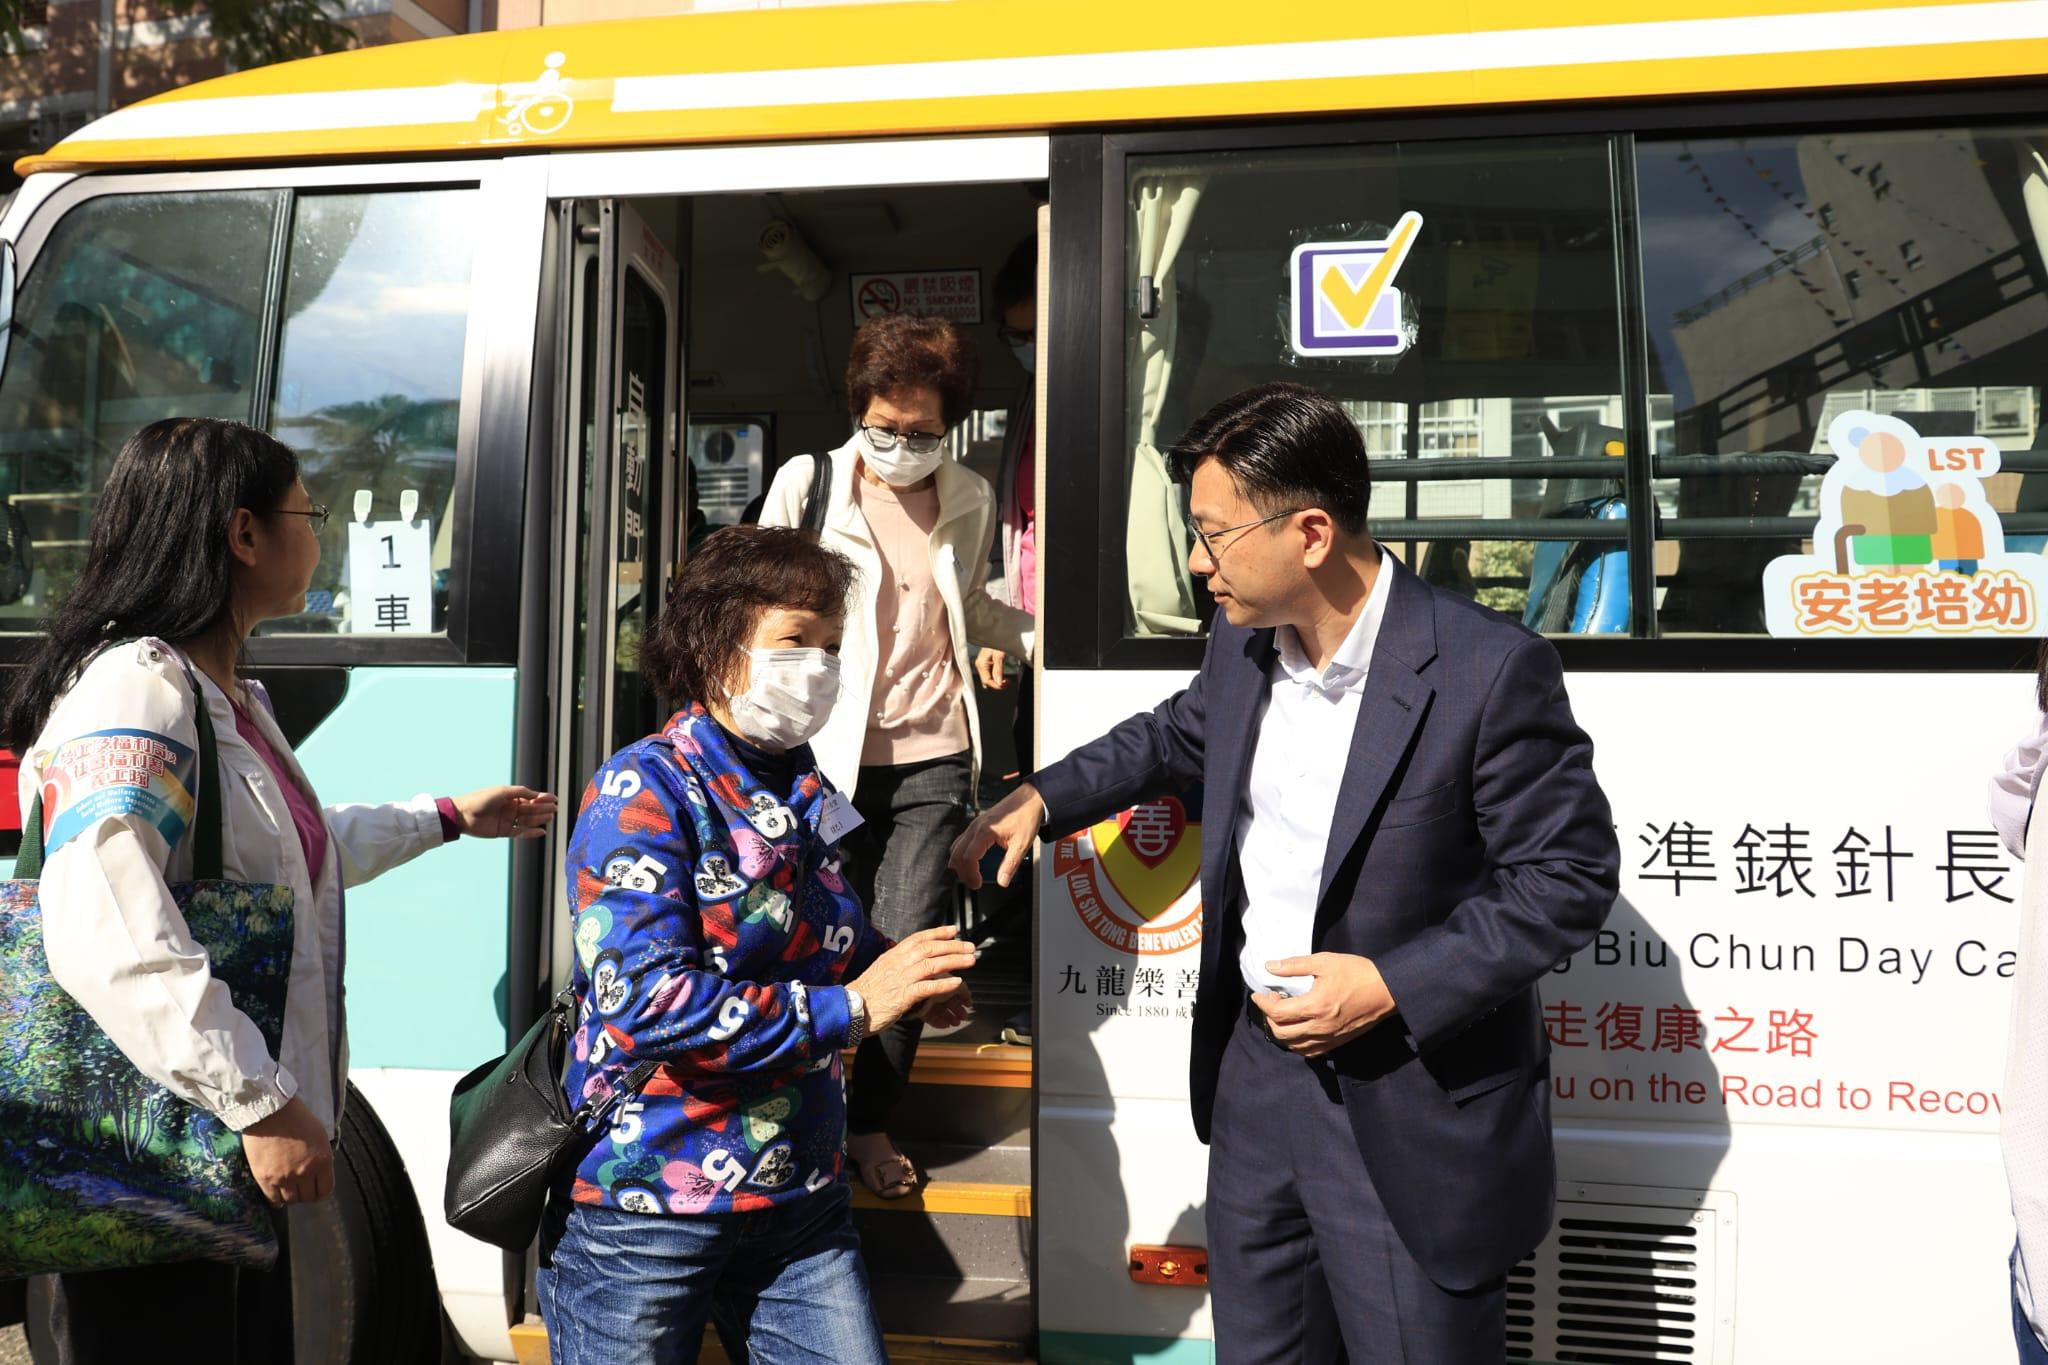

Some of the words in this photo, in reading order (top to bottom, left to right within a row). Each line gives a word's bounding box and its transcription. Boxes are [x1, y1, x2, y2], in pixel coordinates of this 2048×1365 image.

[904, 296, 920, 306] NO
[926, 294, 977, 306] SMOKING
[1928, 447, 1986, 472] LST
[380, 534, 401, 568] 1
[374, 594, 411, 632] 車
[1799, 577, 2029, 627] 安老培幼
[1061, 842, 1075, 860] THE
[1638, 820, 2015, 903] 準錶針長
[1071, 873, 1092, 899] LOK
[1079, 897, 1103, 923] SIN
[1095, 915, 1128, 947] TONG
[1128, 922, 1201, 951] BENEVOLENT
[1595, 929, 1667, 968] Biu
[1689, 932, 1815, 972] Chun
[1839, 936, 1933, 985] Day
[1059, 963, 1200, 999] 九龍樂善
[1096, 1003, 1132, 1017] Since
[1136, 1004, 1169, 1018] 1880
[1543, 1000, 1819, 1058] 走復康之路
[1589, 1077, 1634, 1102] on
[1647, 1072, 1707, 1104] the
[1721, 1075, 1821, 1108] Road
[1836, 1080, 1872, 1111] to
